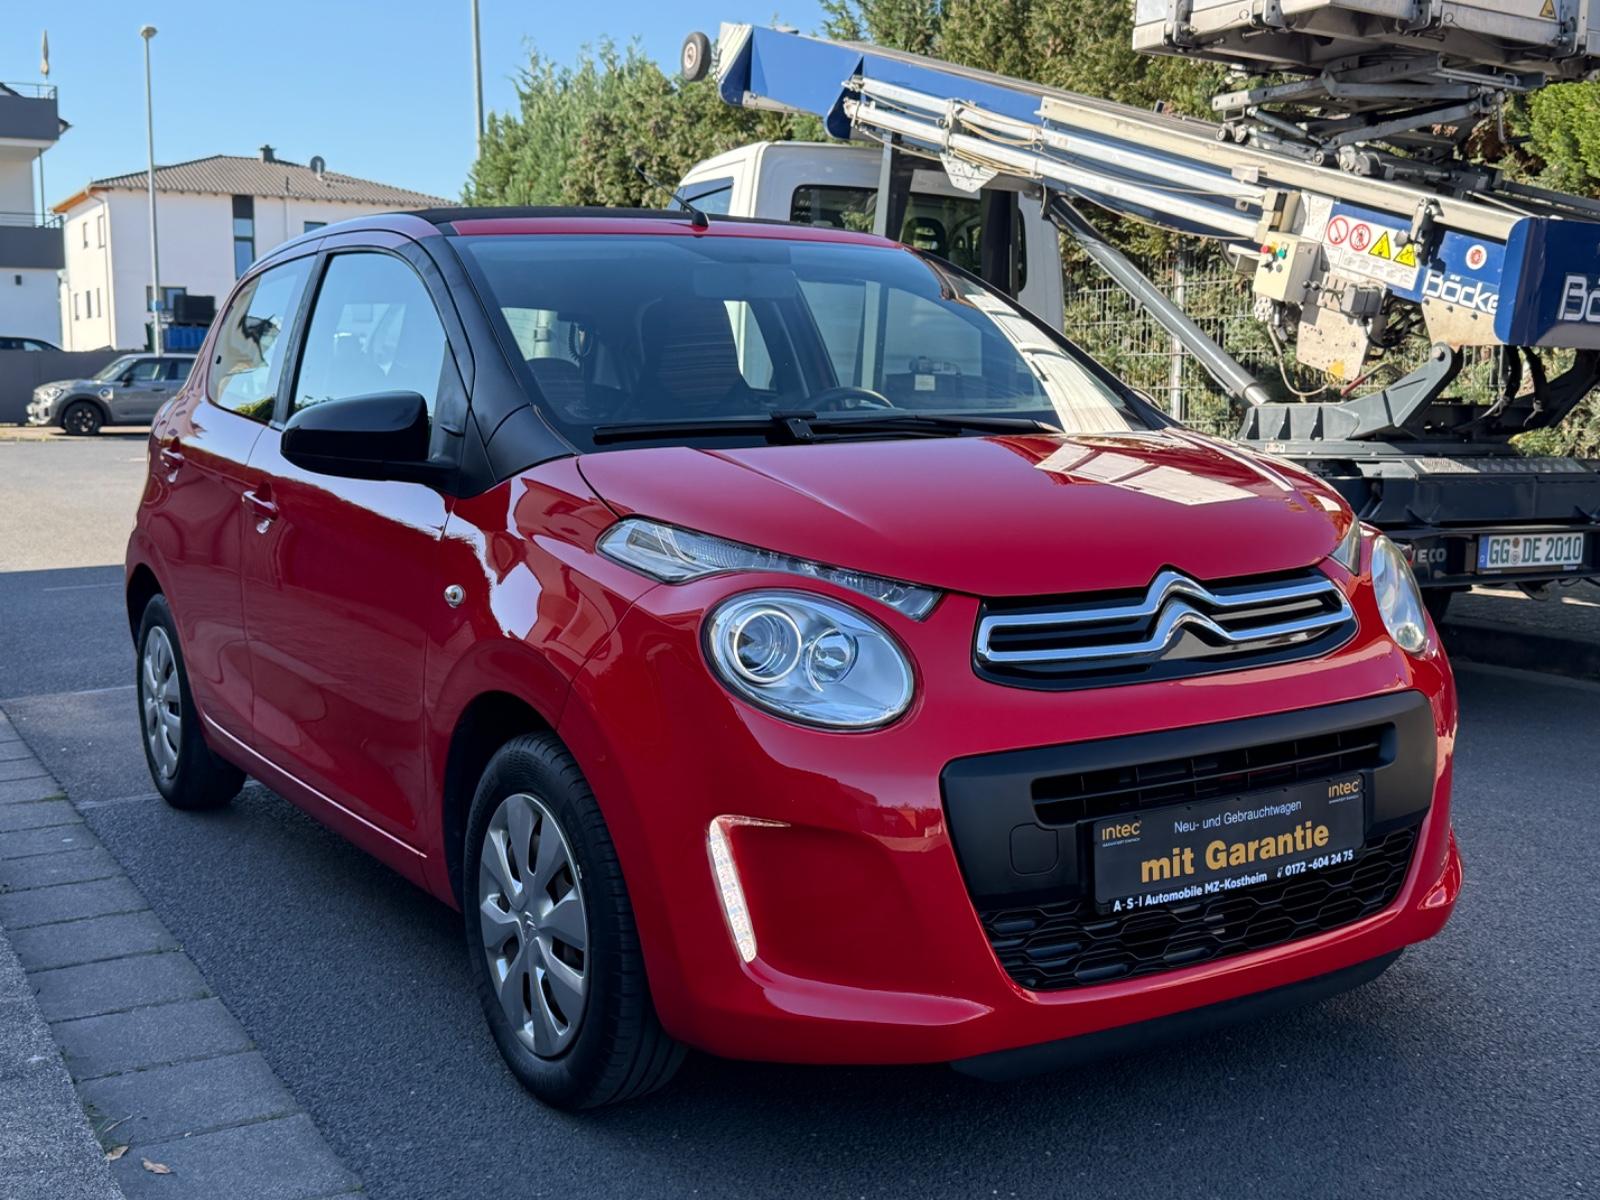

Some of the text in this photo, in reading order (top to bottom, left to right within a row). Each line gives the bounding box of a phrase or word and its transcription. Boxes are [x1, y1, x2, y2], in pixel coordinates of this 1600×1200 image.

[1489, 536, 1582, 564] GG DE 2010
[1328, 781, 1359, 798] intec
[1102, 822, 1141, 840] intec
[1174, 801, 1302, 834] Neu- und Gebrauchtwagen
[1141, 820, 1330, 883] mit Garantie
[1144, 884, 1203, 906] Automobile
[1205, 872, 1268, 894] MZ-Kostheim
[1285, 861, 1306, 876] 0172
[1330, 853, 1342, 865] 24
[1343, 849, 1353, 862] 75
